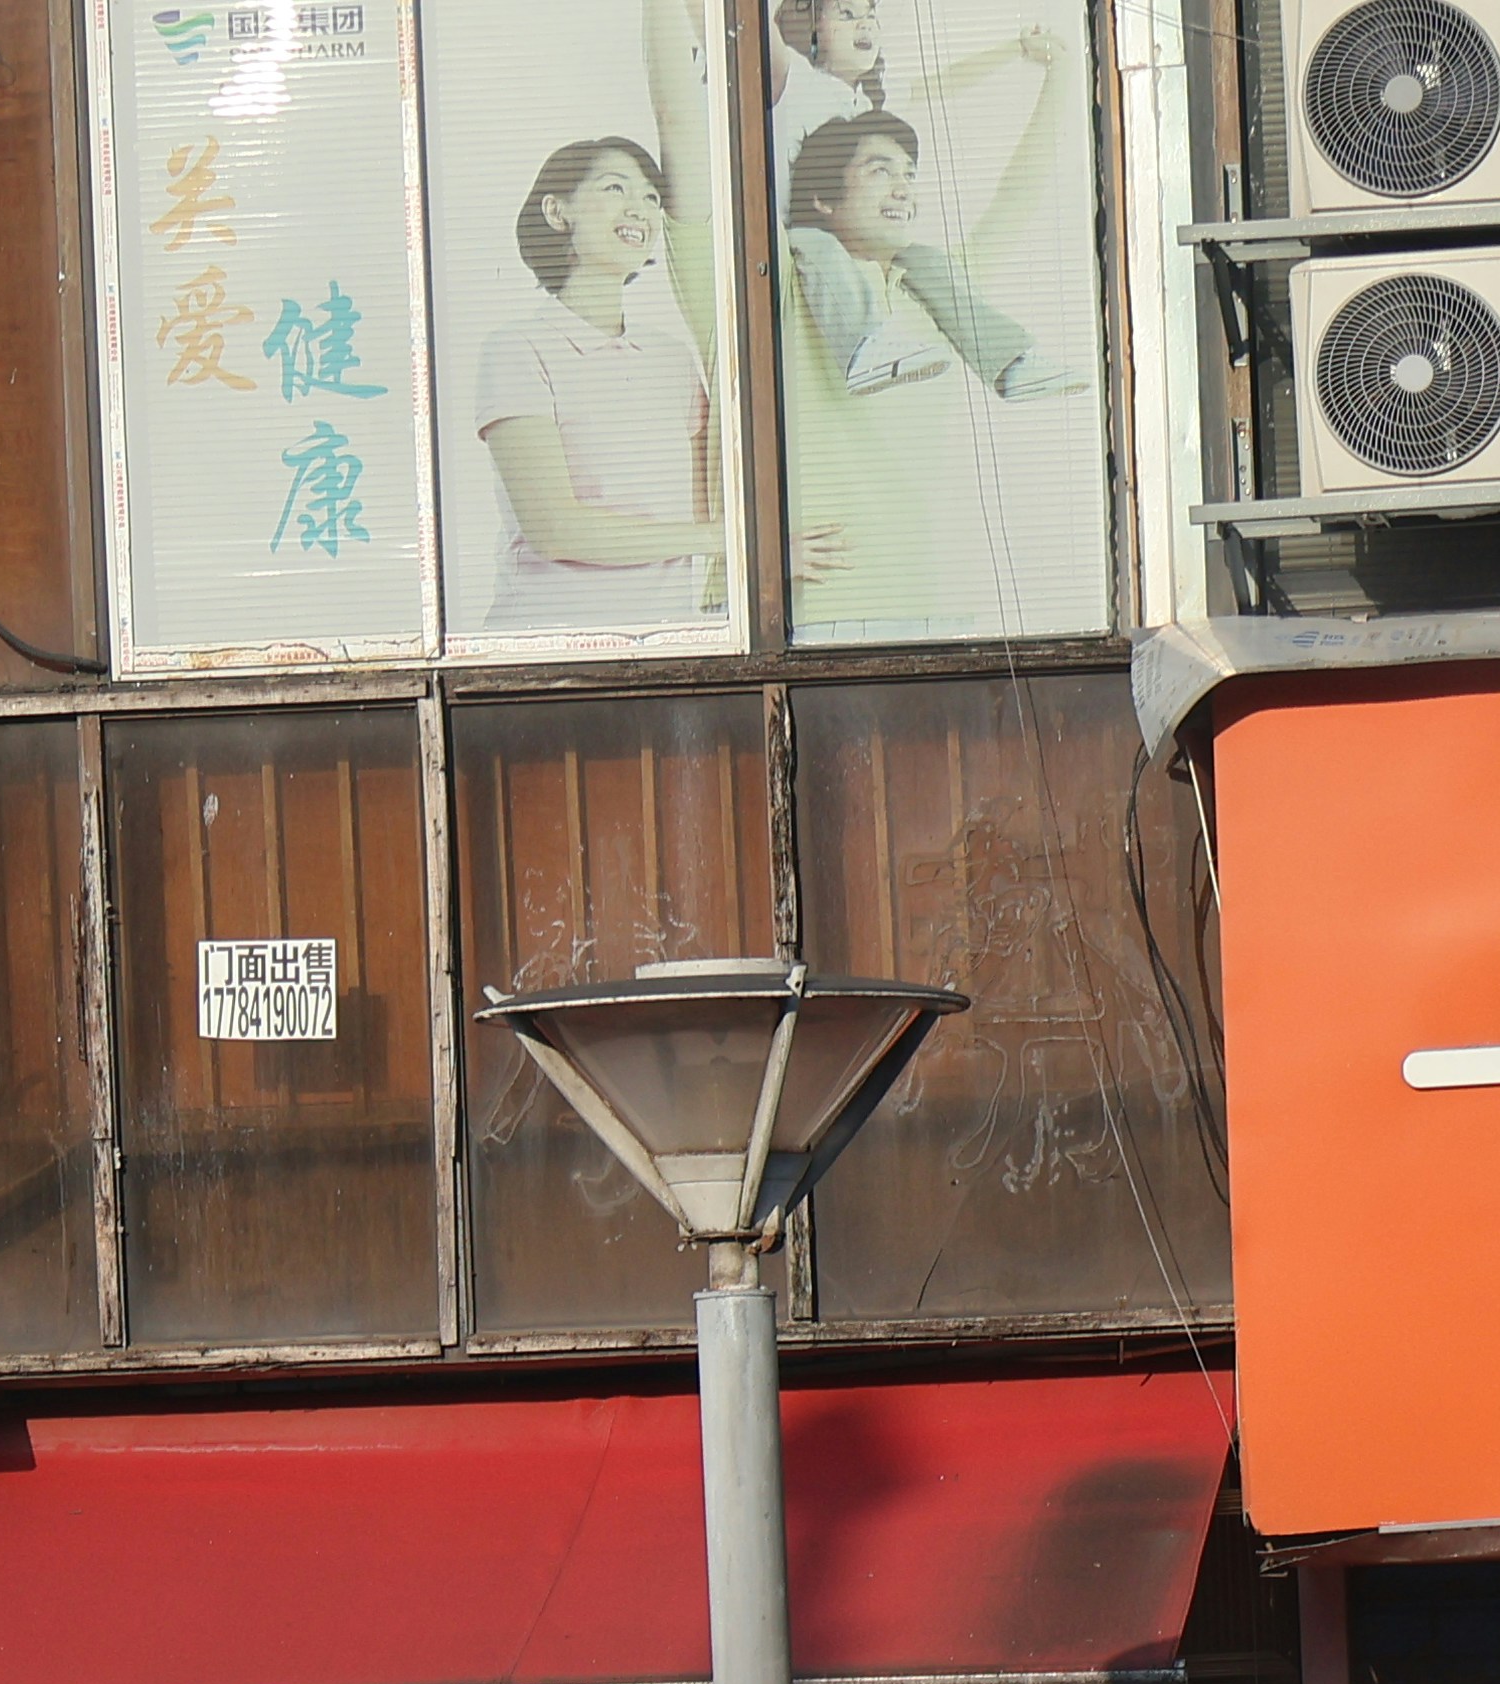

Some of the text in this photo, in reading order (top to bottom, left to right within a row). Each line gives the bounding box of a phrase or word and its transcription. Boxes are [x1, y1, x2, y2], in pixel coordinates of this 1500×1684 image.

[148, 135, 258, 393] 关爱
[264, 280, 388, 560] 健康
[203, 942, 333, 986] 门面出售
[203, 985, 334, 1039] 17784190072
